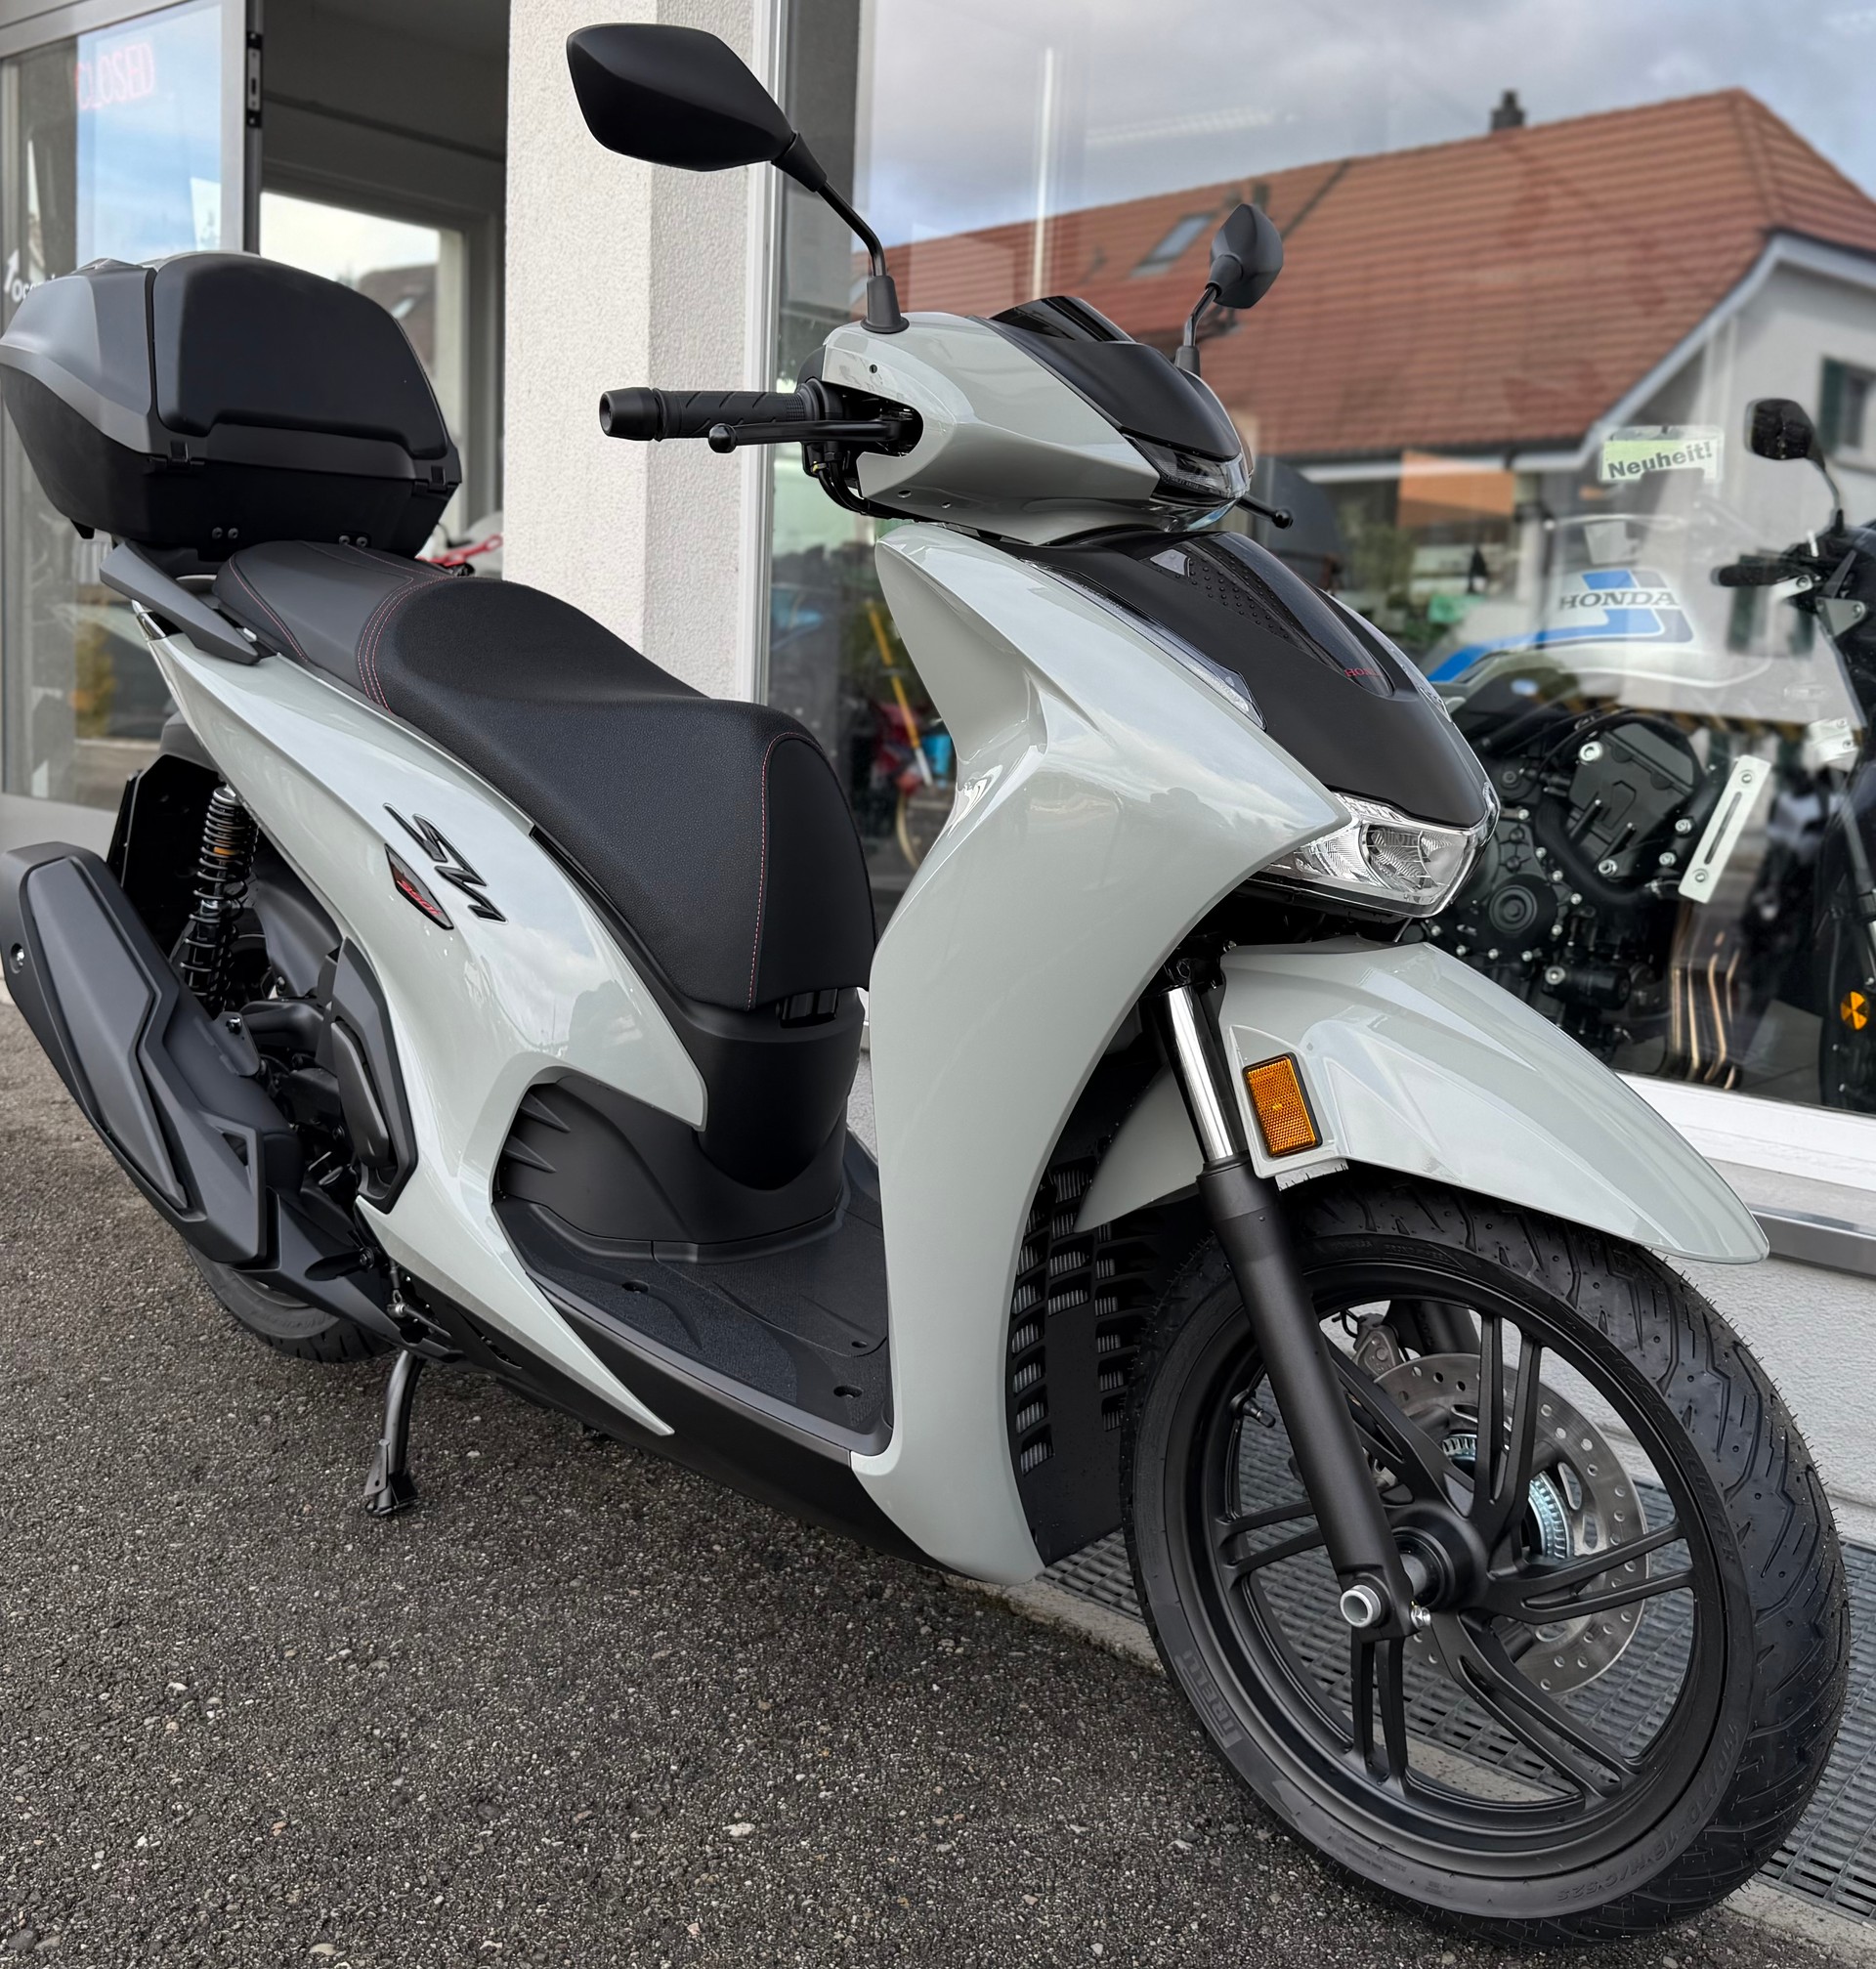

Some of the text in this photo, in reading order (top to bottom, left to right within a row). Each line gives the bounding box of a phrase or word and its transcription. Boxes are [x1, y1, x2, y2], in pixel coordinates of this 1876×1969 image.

[73, 42, 155, 110] CLOSED
[1607, 441, 1713, 479] Neuheit!
[1558, 590, 1680, 611] HONDA
